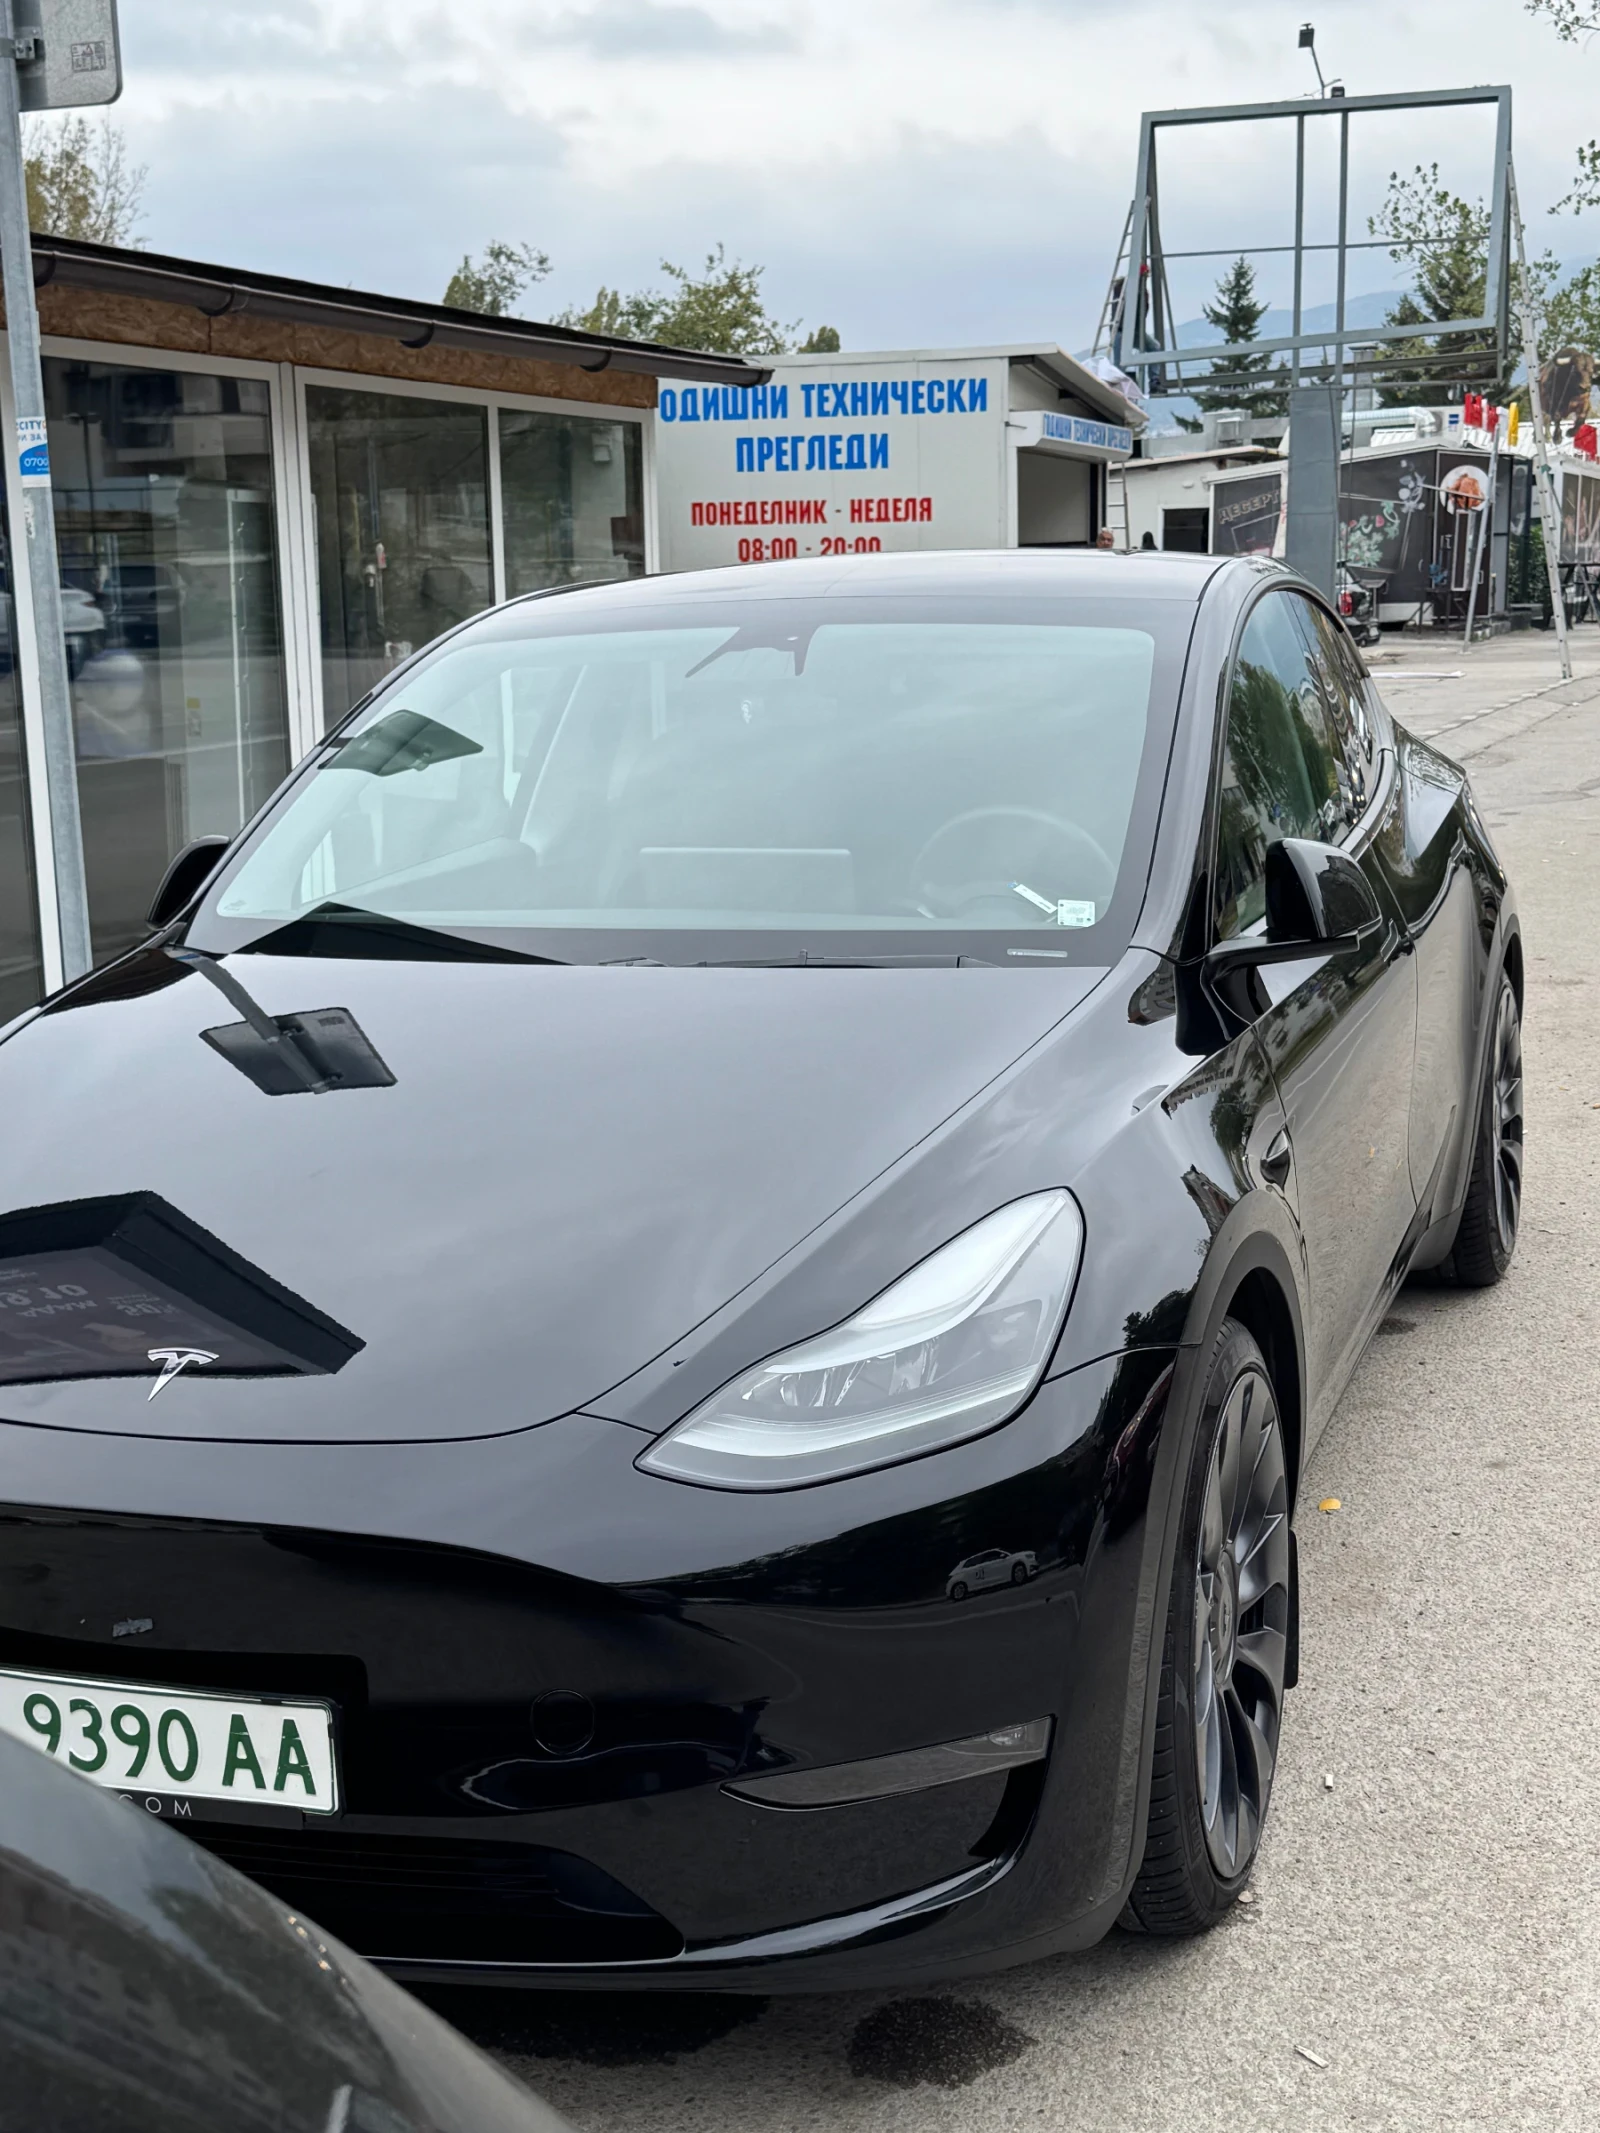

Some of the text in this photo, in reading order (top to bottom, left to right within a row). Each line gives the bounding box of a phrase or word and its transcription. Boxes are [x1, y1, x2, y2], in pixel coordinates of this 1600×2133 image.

[659, 378, 987, 422] ОДИШНИ ТЕХНИЧЕСКИ
[736, 433, 889, 472] ПРЕГЛЕДИ
[691, 500, 827, 526] ПОНЕДЕЛНИК
[850, 497, 933, 523] НЕДЕЛЯ
[738, 537, 797, 563] 08:00
[23, 1693, 316, 1796] 9390 AA
[119, 1794, 192, 1816] OM
